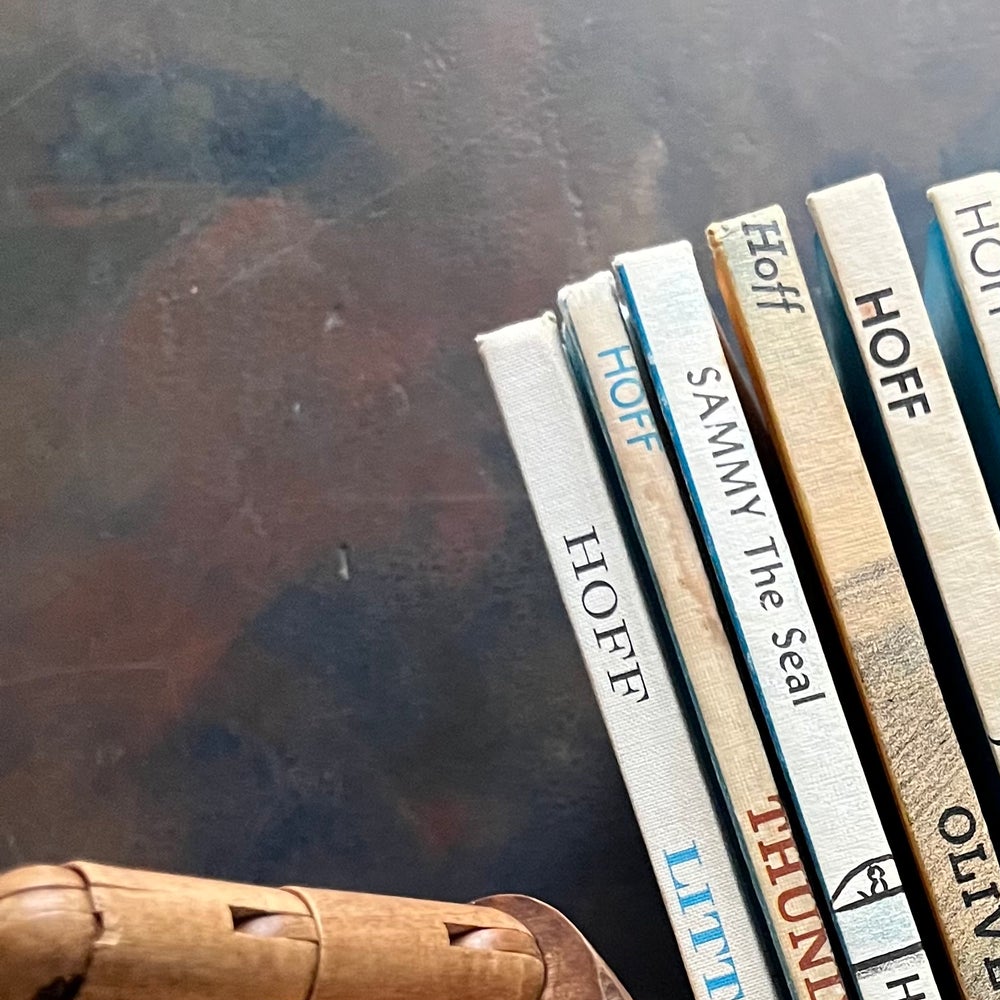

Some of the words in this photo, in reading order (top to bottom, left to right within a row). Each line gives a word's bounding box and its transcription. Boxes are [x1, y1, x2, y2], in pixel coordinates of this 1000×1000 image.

[741, 220, 805, 315] Hoff
[597, 344, 664, 452] HOFF
[853, 287, 931, 419] HOFF
[686, 366, 767, 517] SAMMY
[743, 535, 784, 612] The
[771, 627, 827, 706] Seal
[563, 525, 650, 703] HOFF
